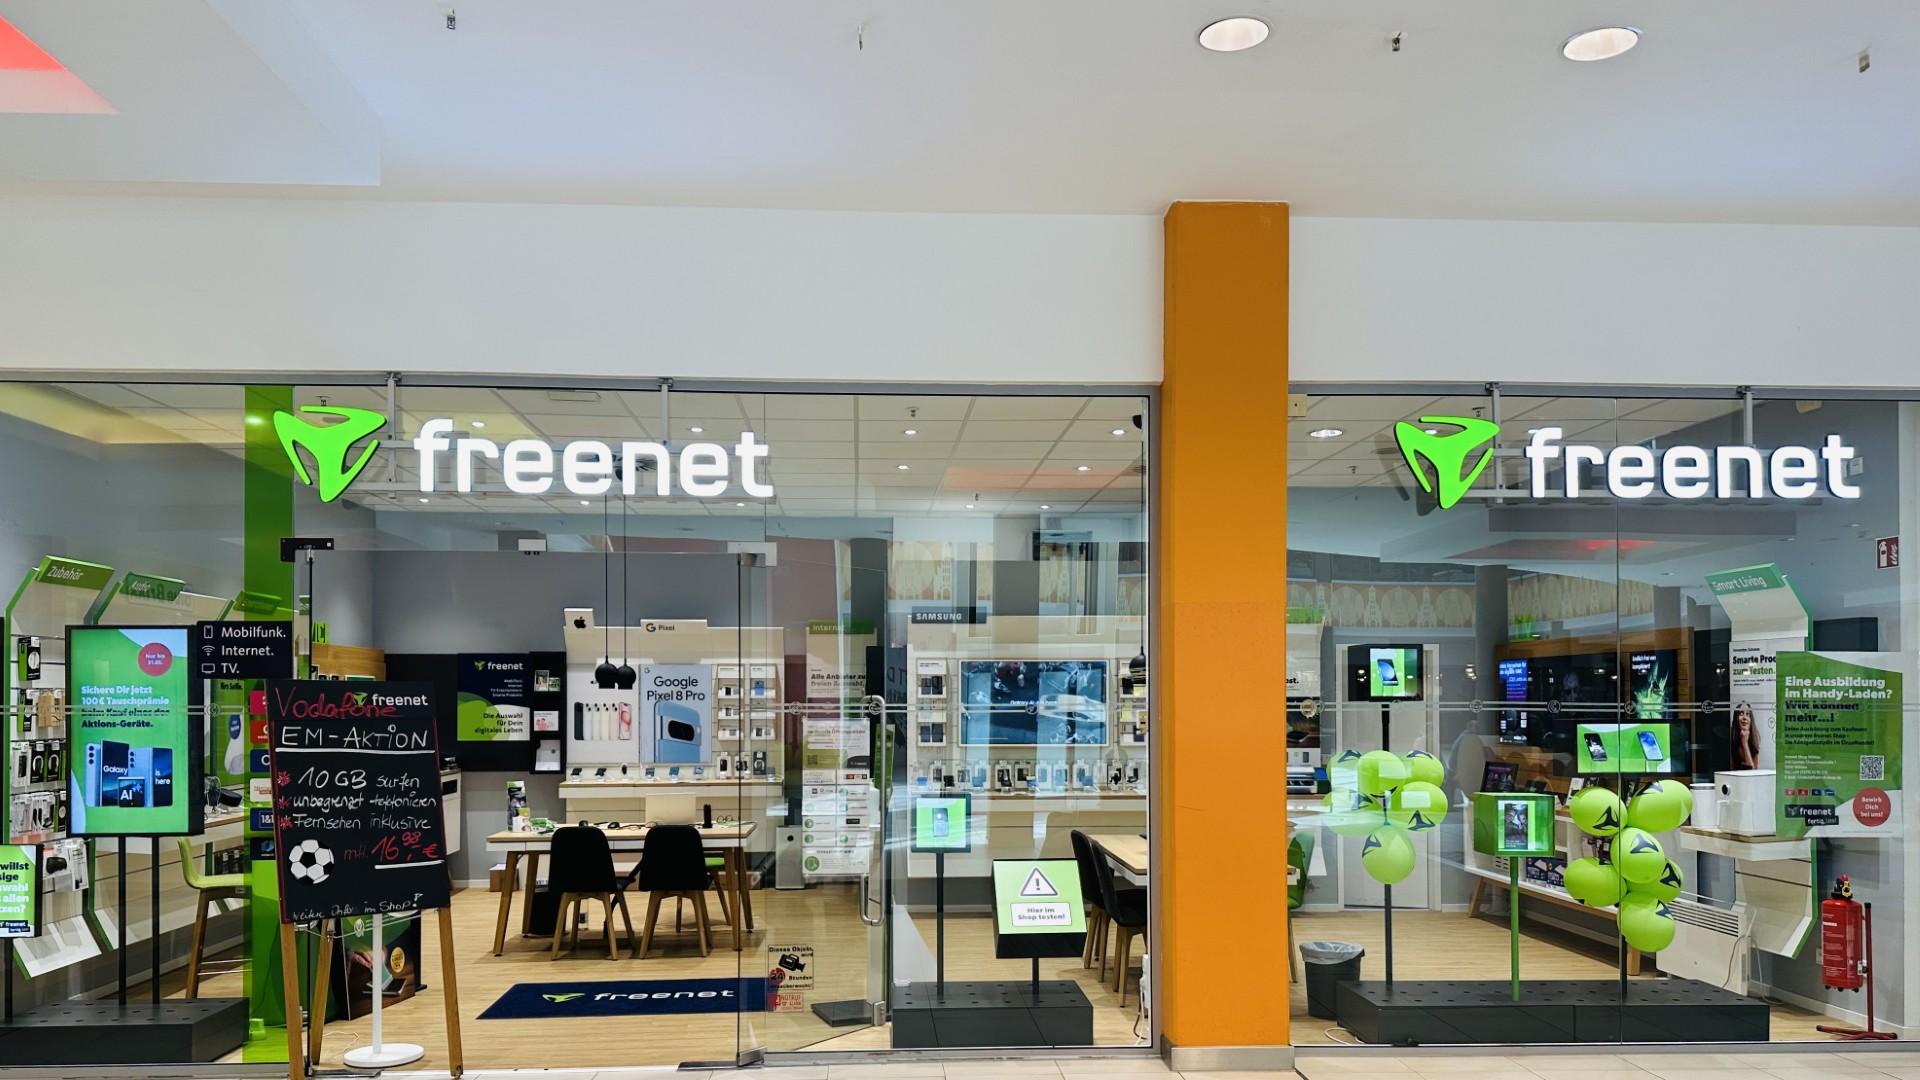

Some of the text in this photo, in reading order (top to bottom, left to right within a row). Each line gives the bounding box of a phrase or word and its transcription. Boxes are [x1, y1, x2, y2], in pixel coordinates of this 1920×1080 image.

[414, 418, 773, 498] freenet
[1525, 427, 1860, 499] freenet
[47, 565, 84, 581] Zubehör
[1712, 576, 1768, 592] Smart Living
[916, 613, 962, 621] SAMSUNG
[221, 626, 287, 638] Mobilfunk.
[221, 645, 274, 656] Internet.
[1733, 655, 1759, 664] Smarte
[221, 663, 240, 674] TV.
[487, 661, 524, 670] freenet
[653, 675, 699, 689] Google
[1785, 676, 1812, 687] Eine
[1813, 676, 1886, 689] Ausbildung
[81, 685, 152, 695] Sichere Dir jetzt
[647, 690, 706, 701] Pixel 8 Pro
[1785, 688, 1893, 700] im Handy-Laden?
[107, 696, 170, 706] Tauschprämie
[275, 686, 401, 720] Vodafone
[371, 693, 429, 706] freenet
[81, 719, 154, 728] Aktions-Geräte.
[474, 727, 502, 735] digitales
[103, 765, 128, 775] Galaxy
[120, 790, 133, 800] AI
[1800, 807, 1832, 816] freenet
[292, 813, 432, 830] Fernsehen inklusive
[594, 989, 735, 1001] freenet
